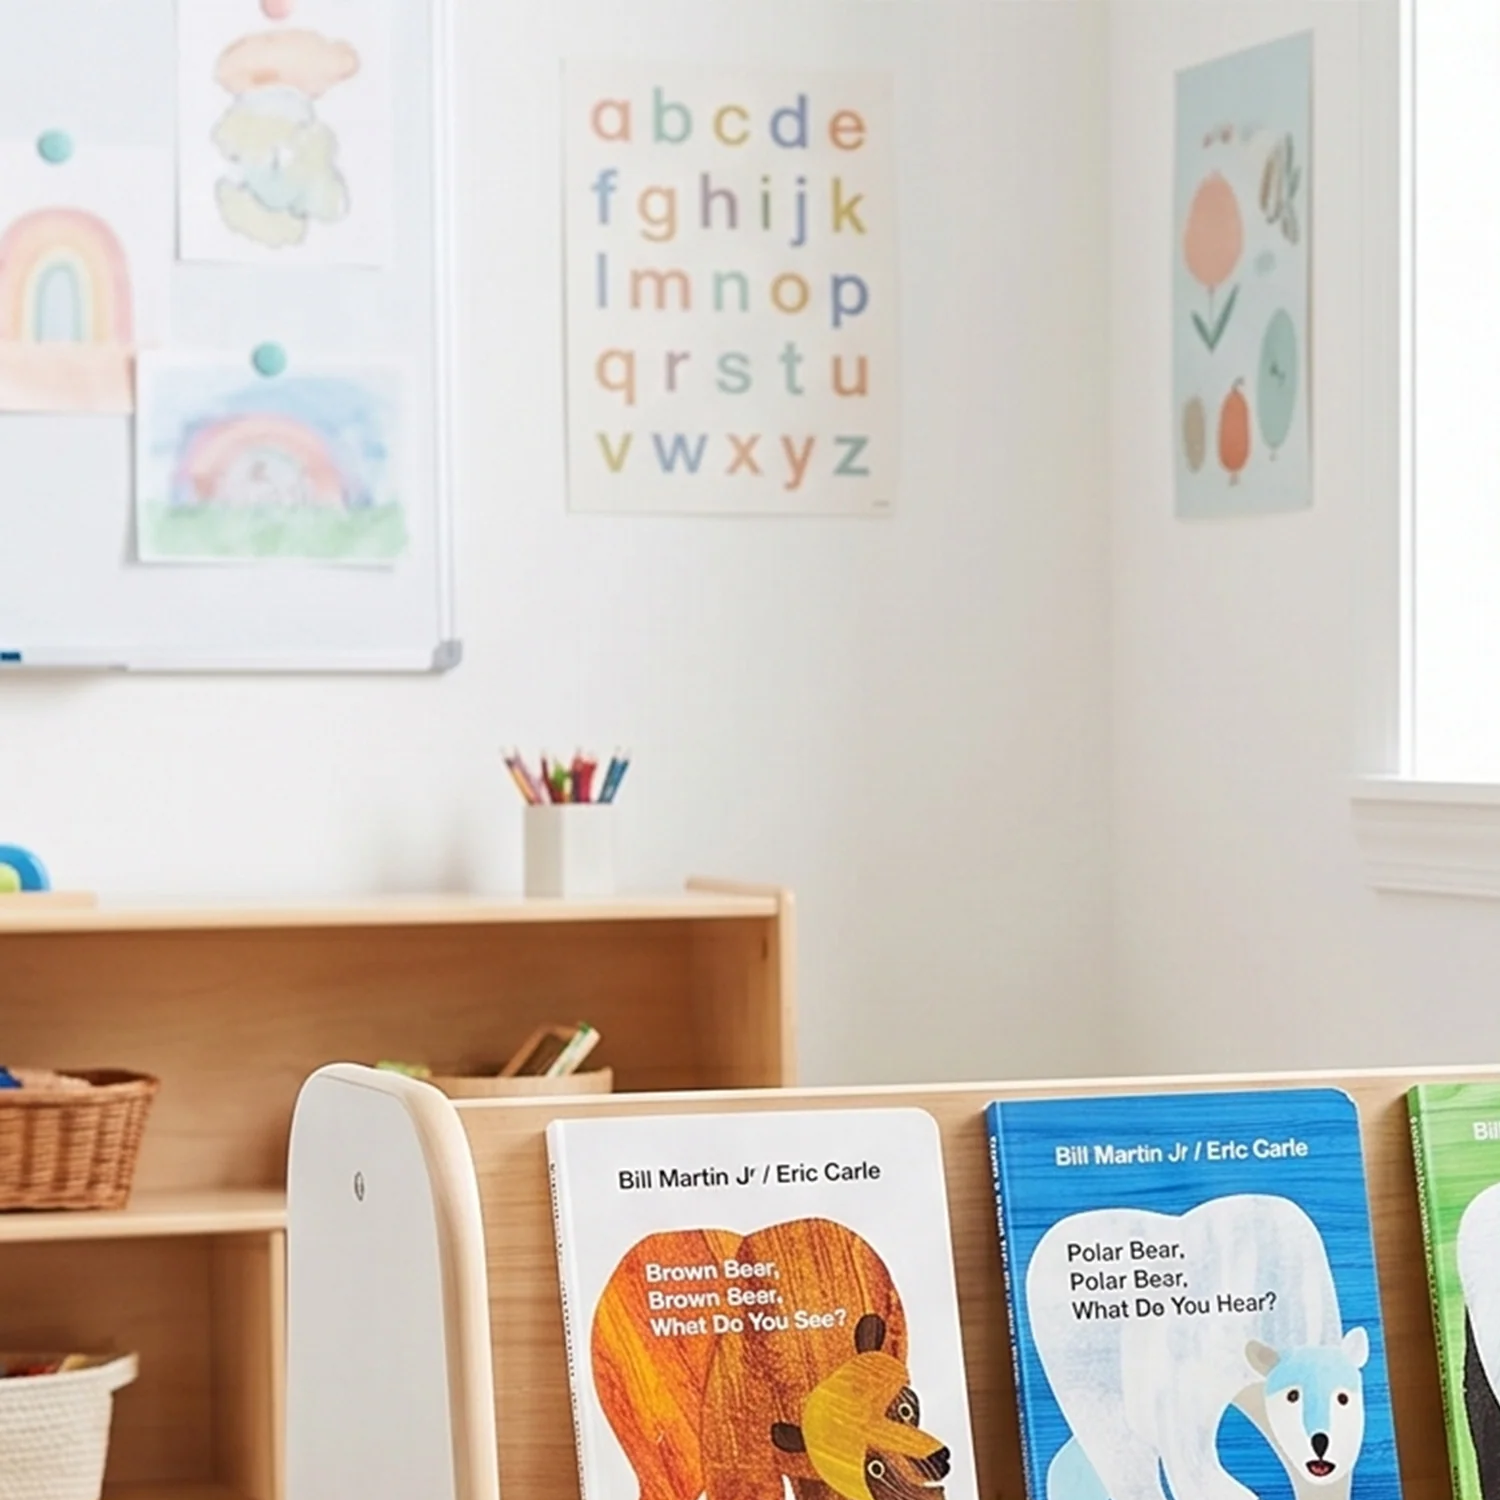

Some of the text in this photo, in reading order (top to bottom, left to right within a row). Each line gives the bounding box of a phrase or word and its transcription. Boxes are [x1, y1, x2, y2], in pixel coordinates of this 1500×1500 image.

[1055, 1146, 1088, 1166] Bill
[1094, 1144, 1162, 1165] Martin
[619, 1170, 652, 1189] Bill
[659, 1167, 729, 1188] Martin
[776, 1163, 818, 1183] Eric
[824, 1161, 881, 1181] Carle
[1067, 1243, 1123, 1262] Polar
[645, 1263, 718, 1282] Brown
[1070, 1271, 1127, 1291] Polar
[649, 1291, 720, 1310] Brown
[1072, 1291, 1277, 1320] What Do You Hear?
[712, 1314, 744, 1334] Do
[748, 1312, 788, 1332] You
[794, 1308, 847, 1328] See?
